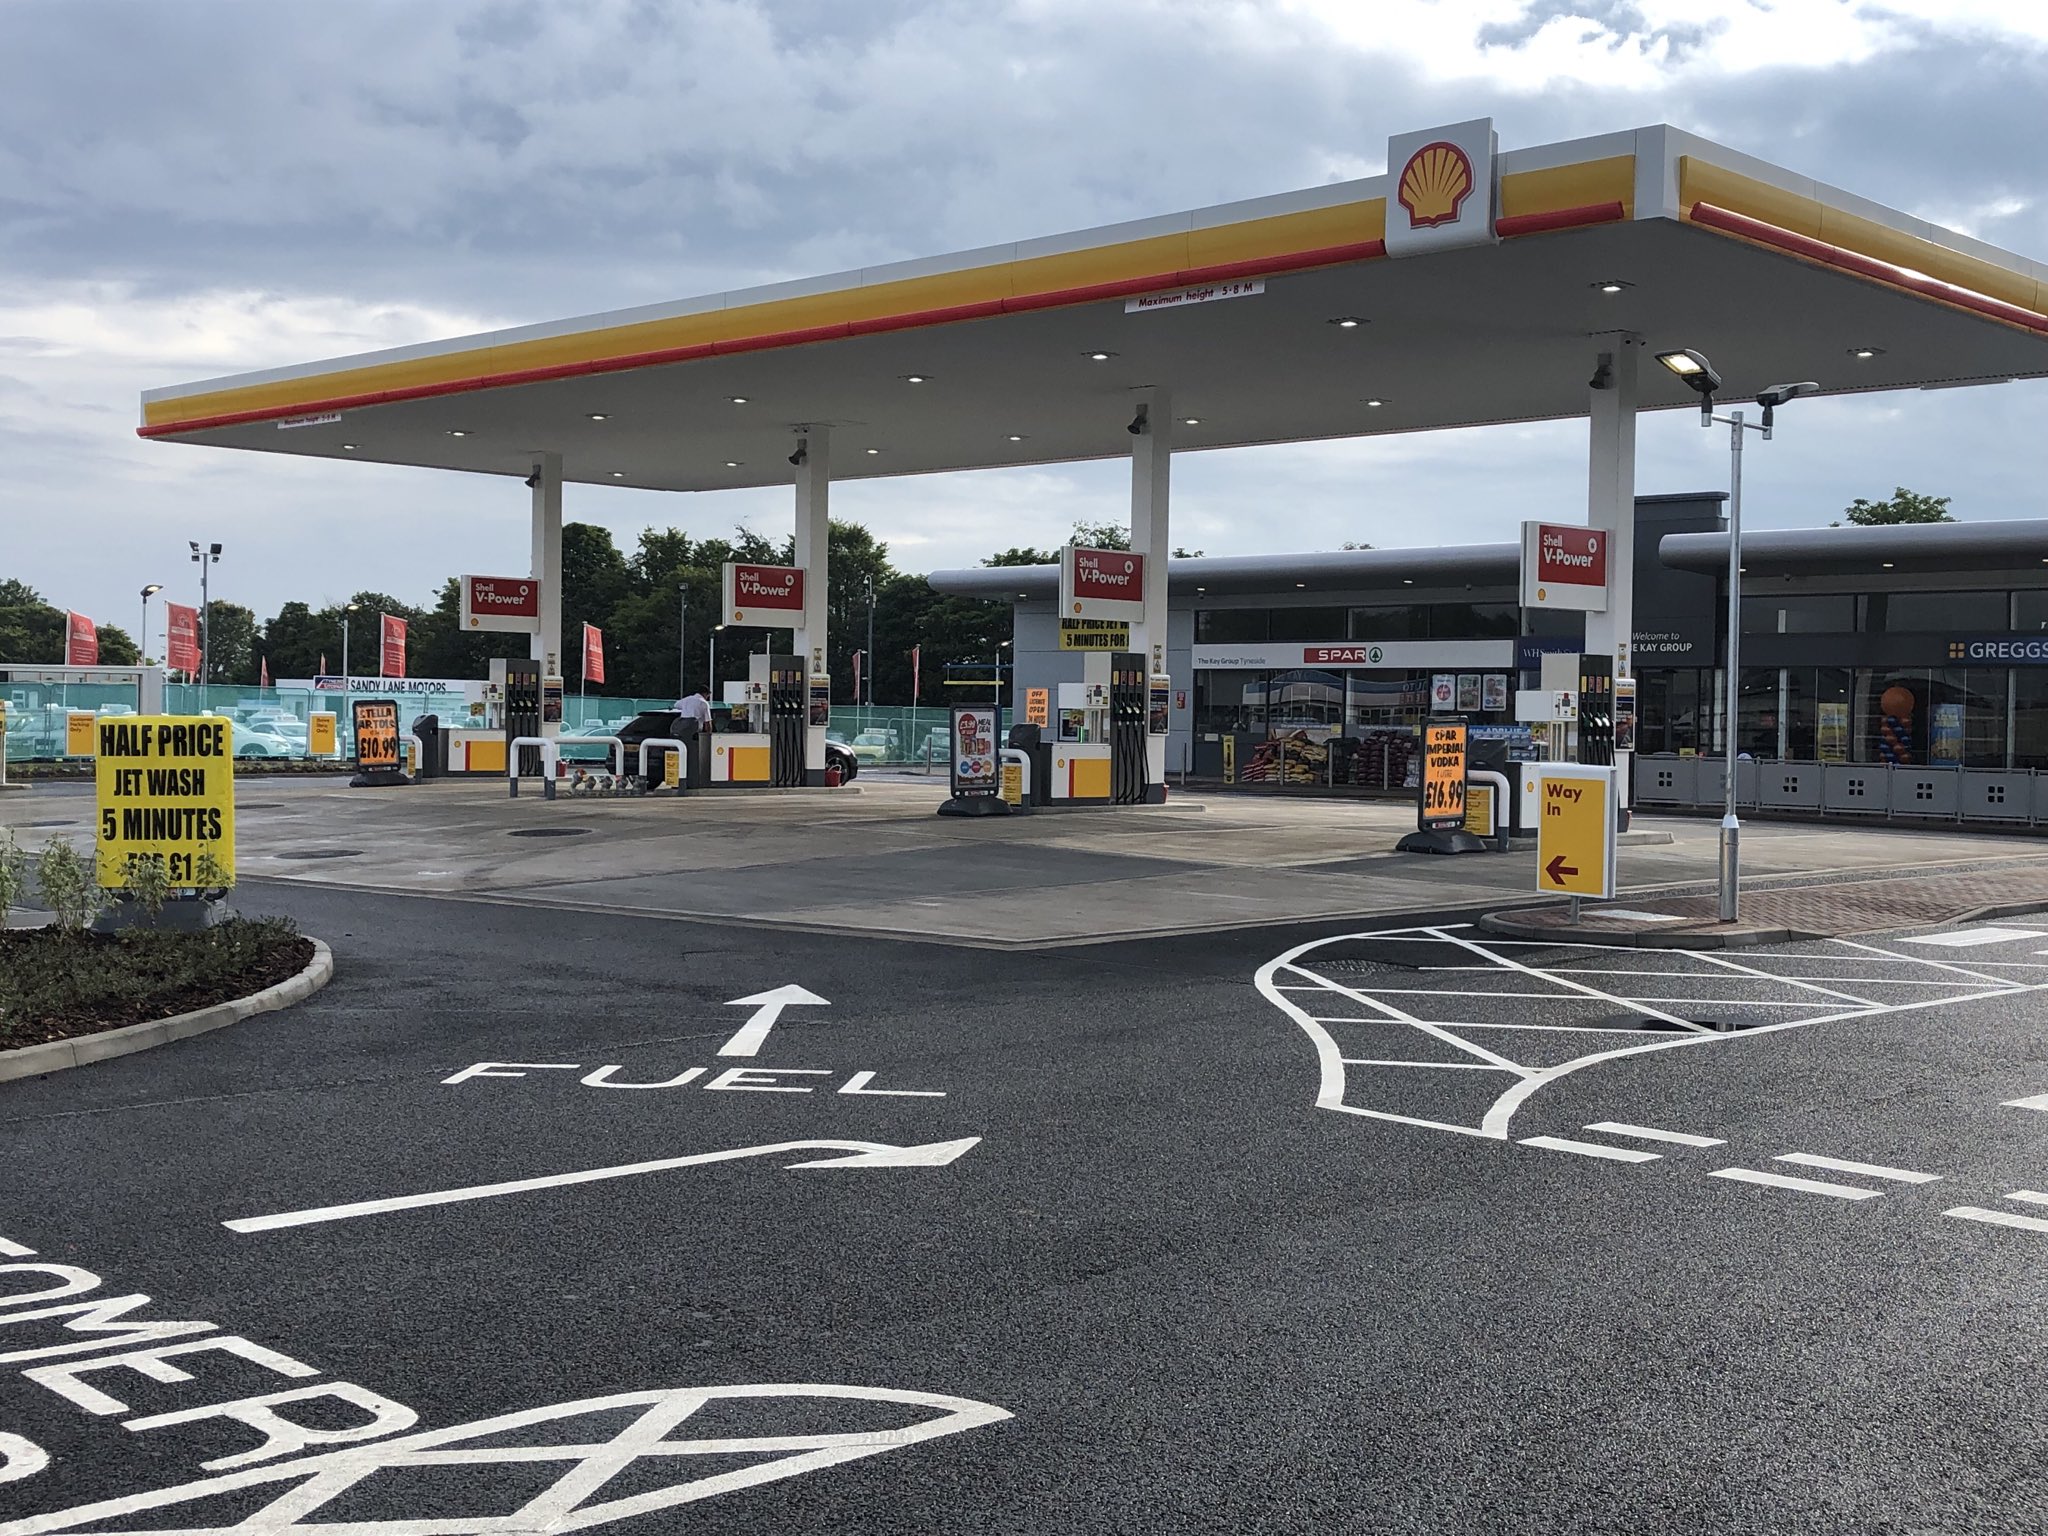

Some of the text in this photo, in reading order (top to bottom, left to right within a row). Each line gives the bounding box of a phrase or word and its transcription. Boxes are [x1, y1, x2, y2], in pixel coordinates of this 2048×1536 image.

[1138, 295, 1182, 308] Maximum
[1186, 288, 1214, 300] height
[1243, 282, 1253, 293] M
[1543, 534, 1563, 547] Shell
[1079, 557, 1098, 568] Shell
[1543, 547, 1593, 568] V-Power
[740, 572, 759, 581] Shell
[1079, 568, 1130, 586] V-Power
[475, 583, 494, 591] Shell
[740, 582, 791, 596] V-Power
[475, 591, 525, 605] V-Power
[1066, 634, 1073, 646] 5
[1073, 634, 1109, 647] MINUTES
[1110, 634, 1125, 647] FOR
[1632, 632, 1680, 641] Welcome to
[1639, 643, 1658, 652] KAY
[1659, 642, 1693, 652] GROUP
[1969, 642, 2048, 658] GREGGS
[1318, 650, 1366, 661] SPAR
[350, 680, 380, 692] SANDY
[383, 681, 405, 693] LANE
[408, 682, 446, 695] MOTORS
[359, 707, 392, 719] STELLA
[357, 719, 396, 730] ARTOIS
[100, 723, 224, 757] HALF PRICE
[1434, 729, 1457, 741] SPAR
[360, 737, 396, 759] £10.99
[1426, 742, 1465, 754] IMPERIAL
[1430, 755, 1460, 768] VODKA
[113, 768, 206, 796] JET WASH
[1425, 779, 1463, 809] £16.99
[1546, 783, 1583, 803] Way
[1547, 801, 1561, 816] In
[102, 807, 222, 841] 5 MINUTES
[169, 852, 192, 881] £1
[440, 1062, 947, 1098] FUEL
